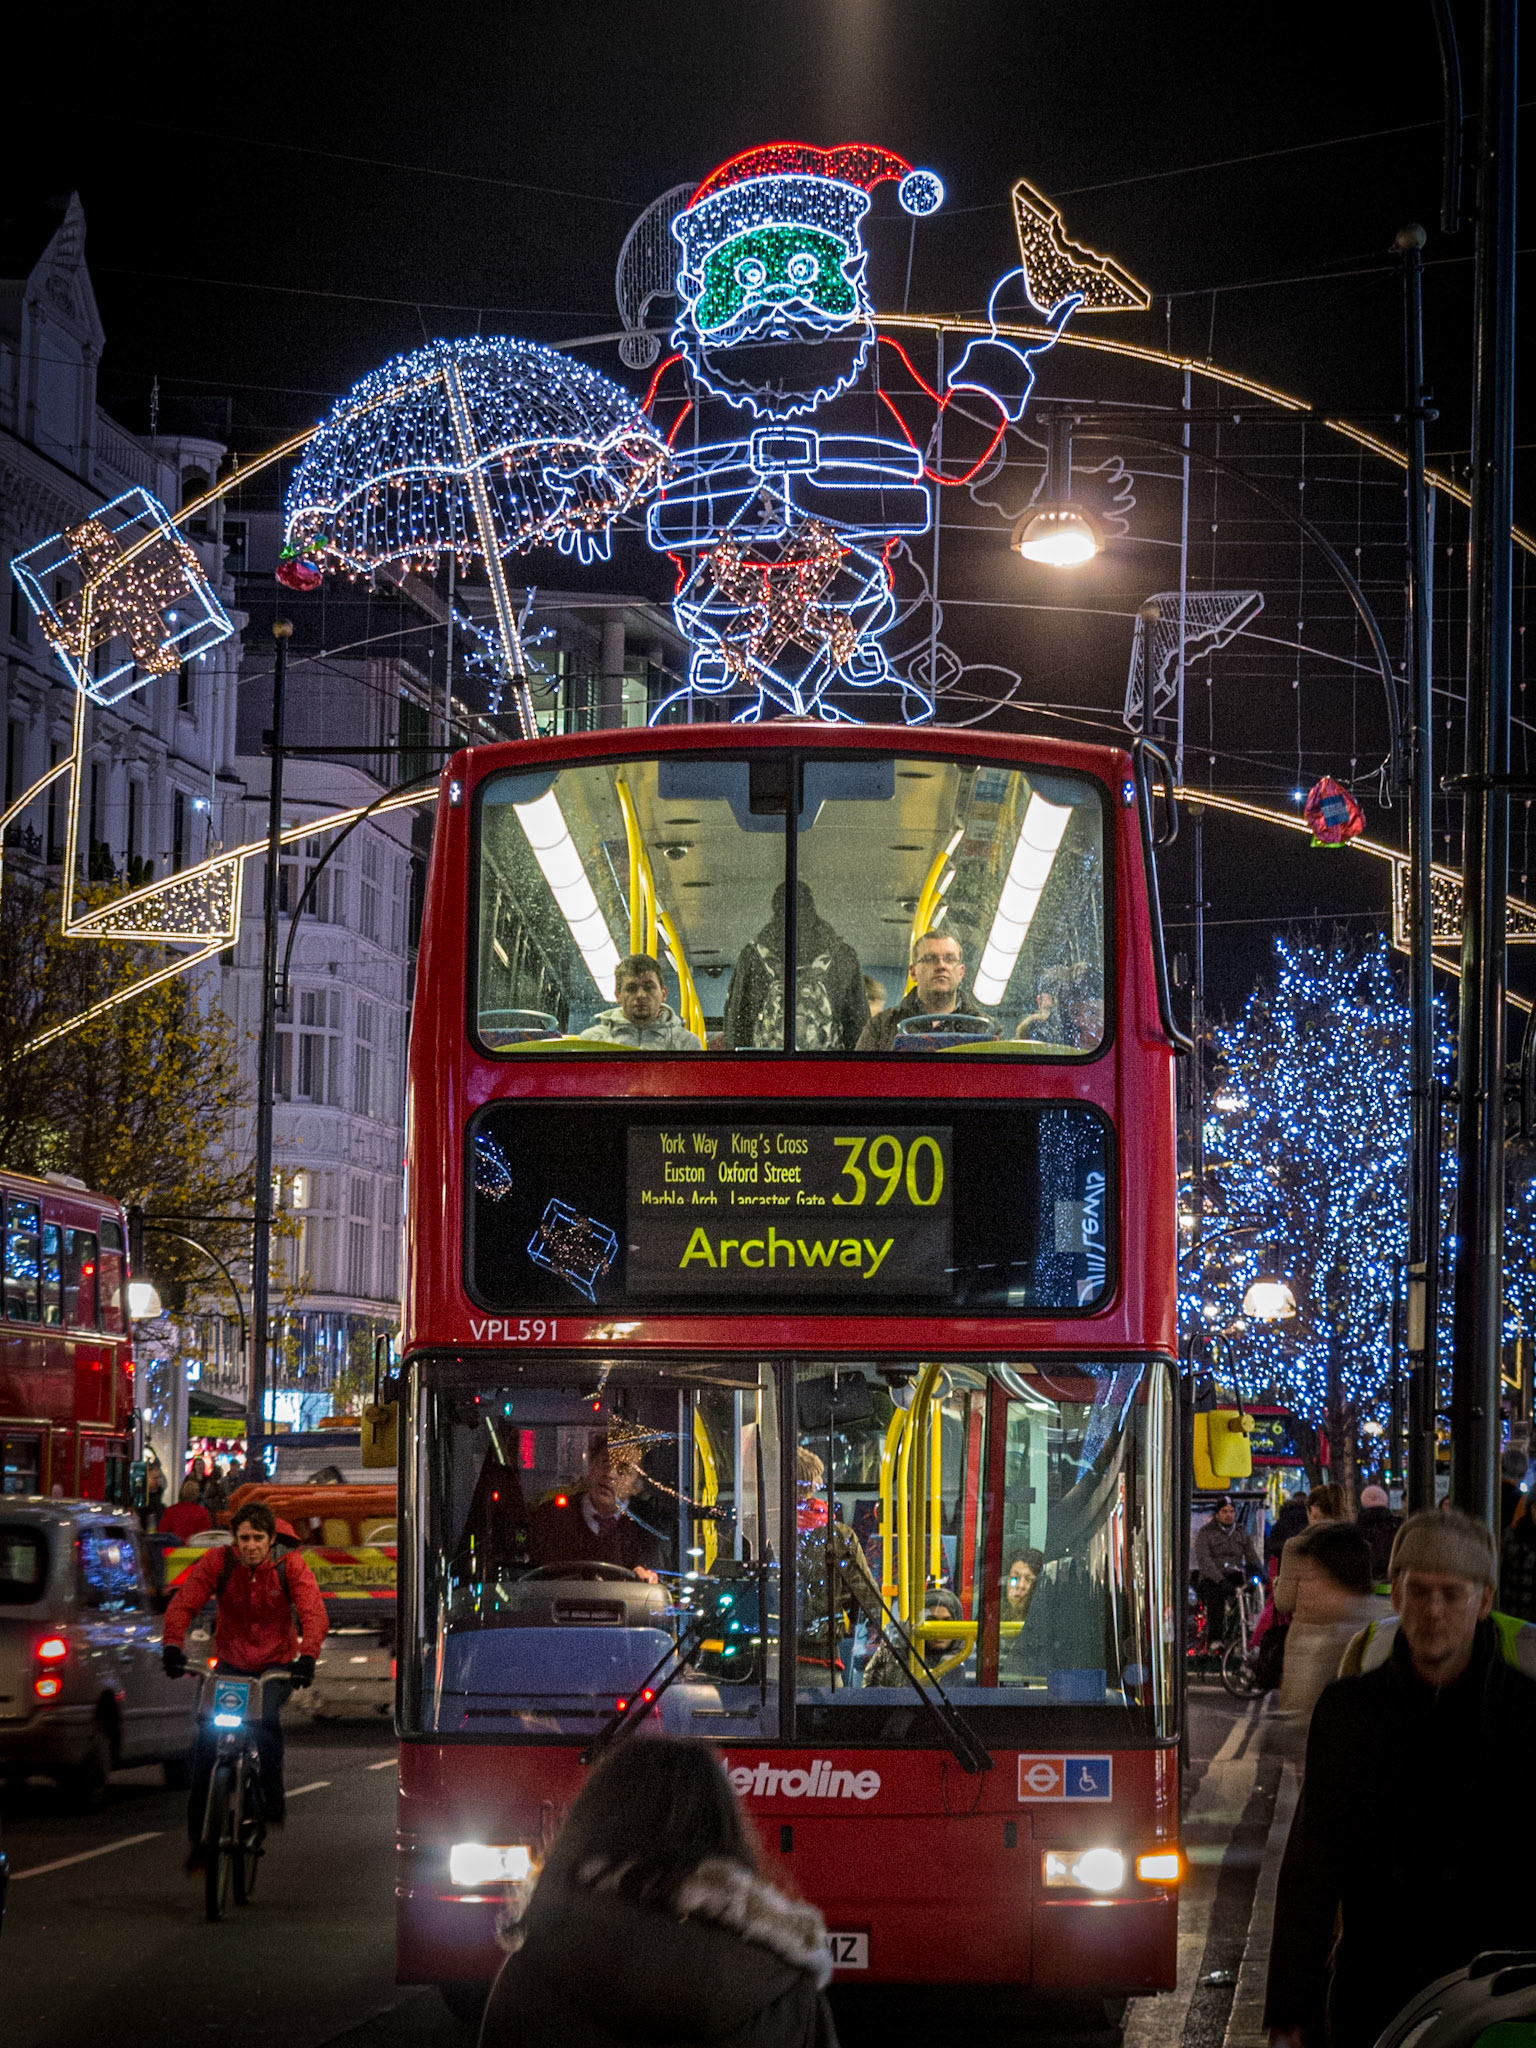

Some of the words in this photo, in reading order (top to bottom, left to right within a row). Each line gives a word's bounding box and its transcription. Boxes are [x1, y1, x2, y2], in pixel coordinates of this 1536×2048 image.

[660, 1133, 685, 1154] York
[692, 1133, 718, 1160] Way
[731, 1133, 770, 1159] King's
[776, 1133, 809, 1155] Cross
[665, 1161, 705, 1183] Euston
[718, 1161, 758, 1183] Oxford
[764, 1161, 802, 1183] Street
[832, 1135, 944, 1206] 390
[679, 1226, 895, 1279] Archway
[469, 1319, 557, 1341] VPL591
[721, 1757, 882, 1800] etroline
